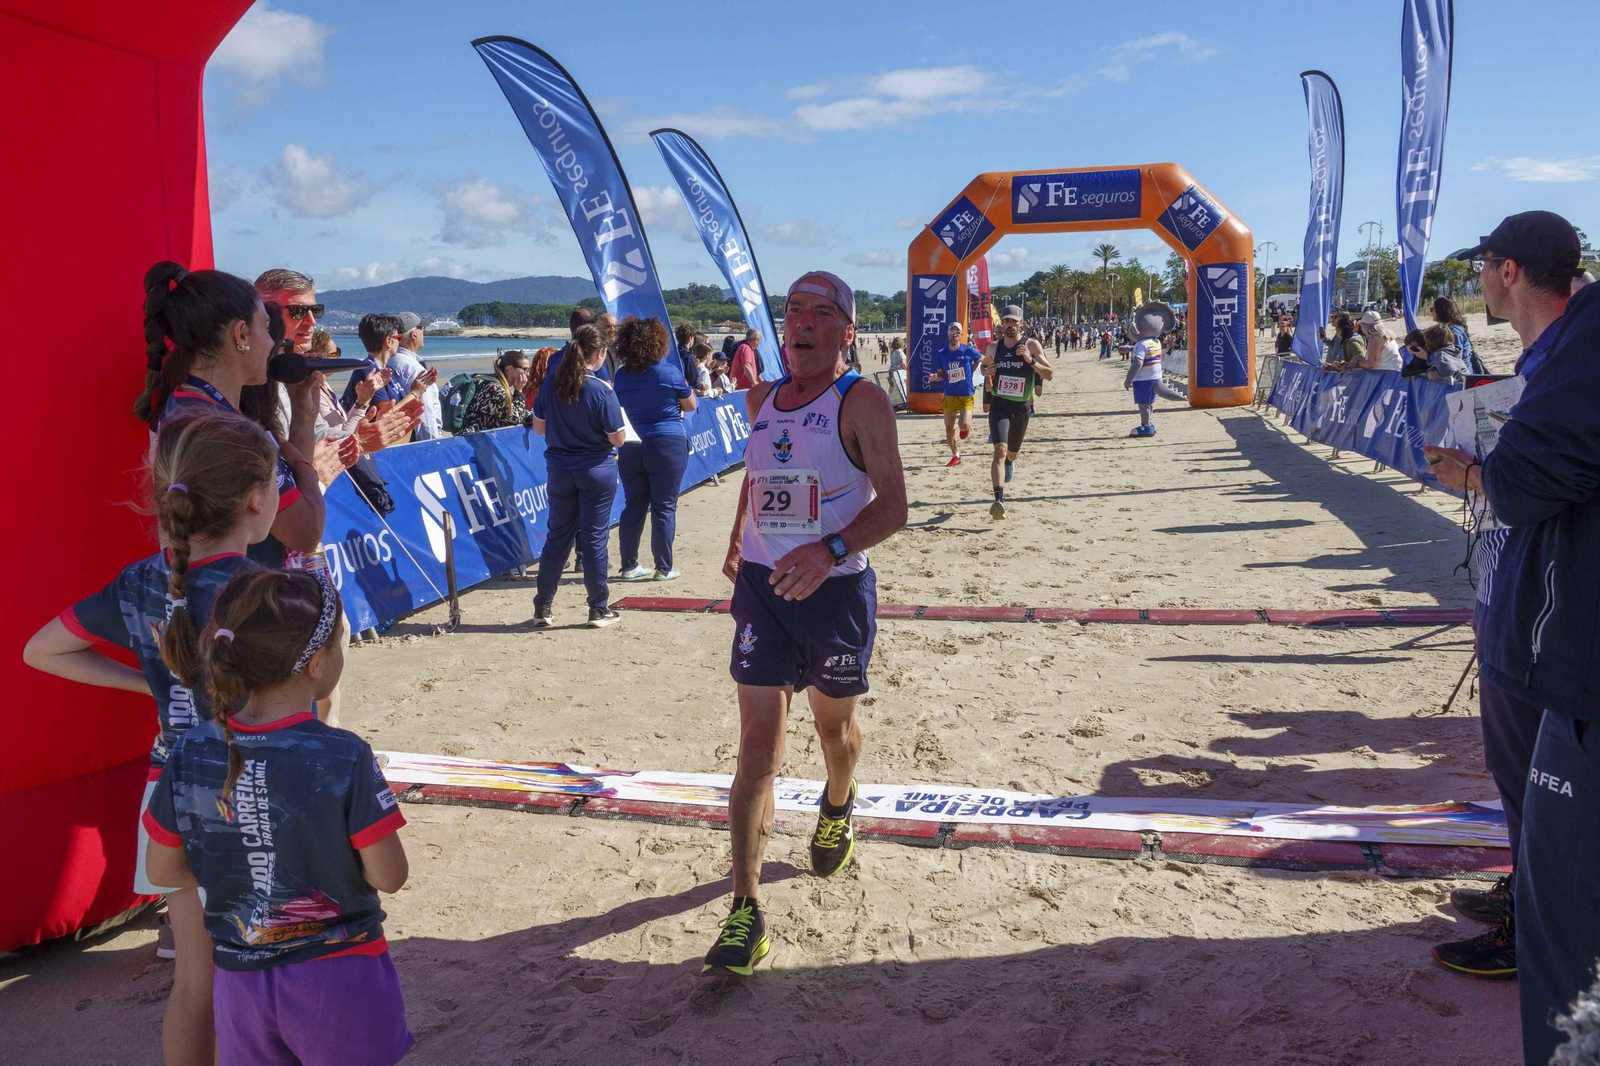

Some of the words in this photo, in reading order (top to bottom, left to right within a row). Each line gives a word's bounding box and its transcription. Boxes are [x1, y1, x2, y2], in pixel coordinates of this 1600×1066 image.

[1046, 181, 1077, 207] FE
[1081, 189, 1136, 208] seguros
[950, 210, 974, 231] FE
[957, 215, 985, 242] seguros
[1176, 213, 1206, 240] seguros
[1188, 204, 1210, 229] FE
[923, 305, 946, 336] FE
[1213, 295, 1238, 327] FE
[920, 339, 933, 390] seguros
[1209, 330, 1224, 384] seguros
[1004, 381, 1019, 390] 578
[725, 404, 749, 441] FE
[808, 426, 832, 435] seguros
[815, 413, 830, 428] FE
[691, 428, 717, 456] seguros
[446, 464, 510, 535] FE
[762, 491, 791, 511] 29
[833, 665, 860, 673] seguros
[840, 654, 857, 666] FE
[168, 684, 191, 727] 100
[255, 760, 267, 794] SAMIL
[1531, 768, 1573, 797] RFEA
[236, 760, 263, 847] CARREIRA
[258, 797, 269, 812] DE
[895, 799, 1092, 821] CARREIRA
[903, 791, 978, 802] SAMIL
[980, 793, 1010, 806] DE
[1014, 798, 1091, 811] PRAIA
[259, 813, 274, 847] PRAIA
[247, 851, 269, 891] 100
